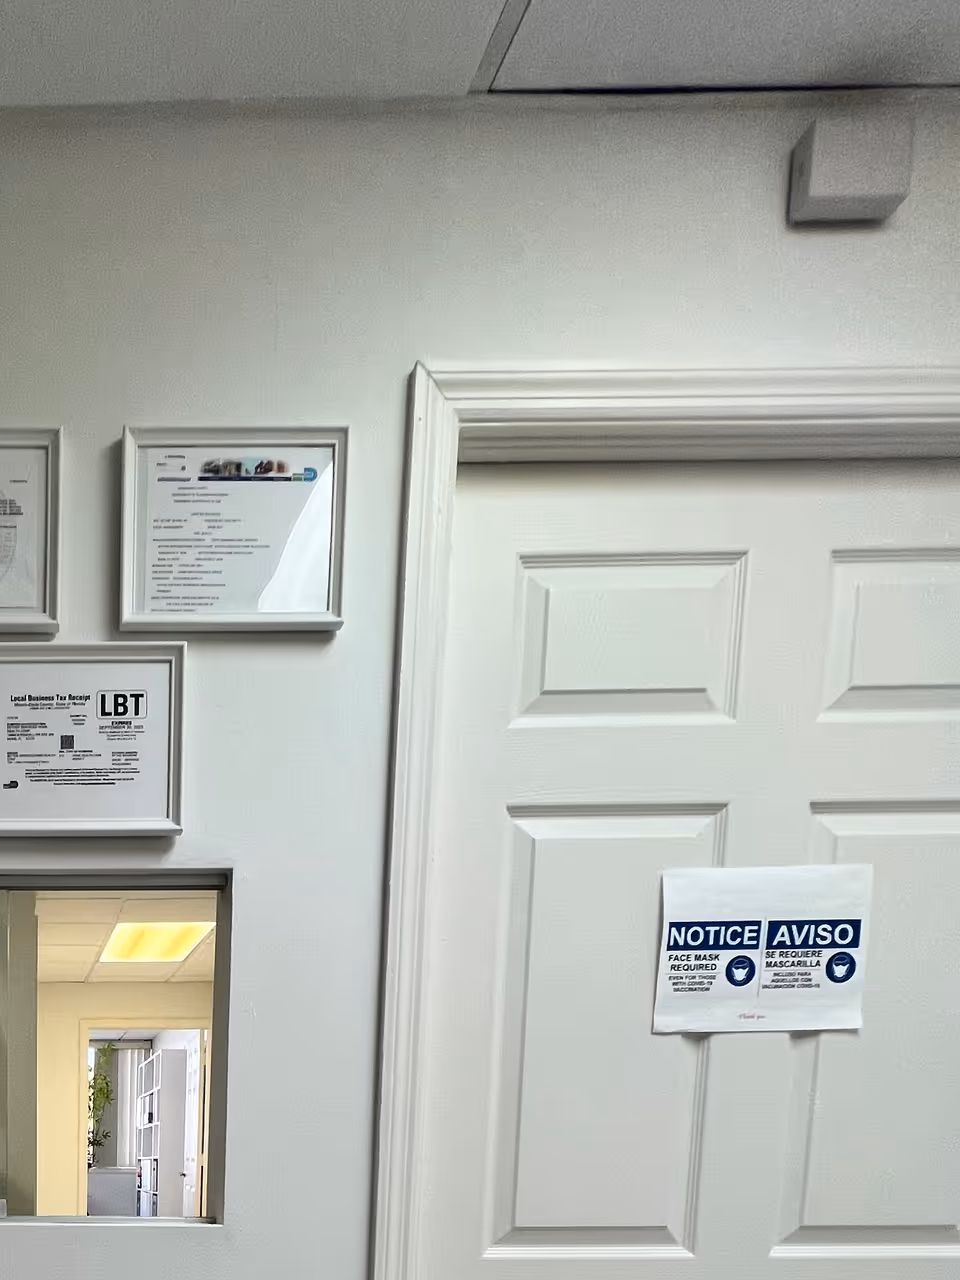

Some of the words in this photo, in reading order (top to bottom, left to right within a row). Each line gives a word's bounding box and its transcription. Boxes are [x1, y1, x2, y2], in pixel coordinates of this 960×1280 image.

[10, 694, 27, 702] Local
[28, 694, 54, 702] Business
[68, 693, 91, 702] Receipt
[100, 693, 144, 716] LBT
[669, 925, 759, 946] NOTICE
[772, 923, 854, 946] AVISO
[668, 954, 692, 962] FACE
[694, 953, 721, 962] MASK
[765, 950, 777, 959] SE
[778, 950, 823, 958] REQUIERE
[670, 963, 717, 972] REQUIRED
[765, 960, 821, 968] MASCARILLA
